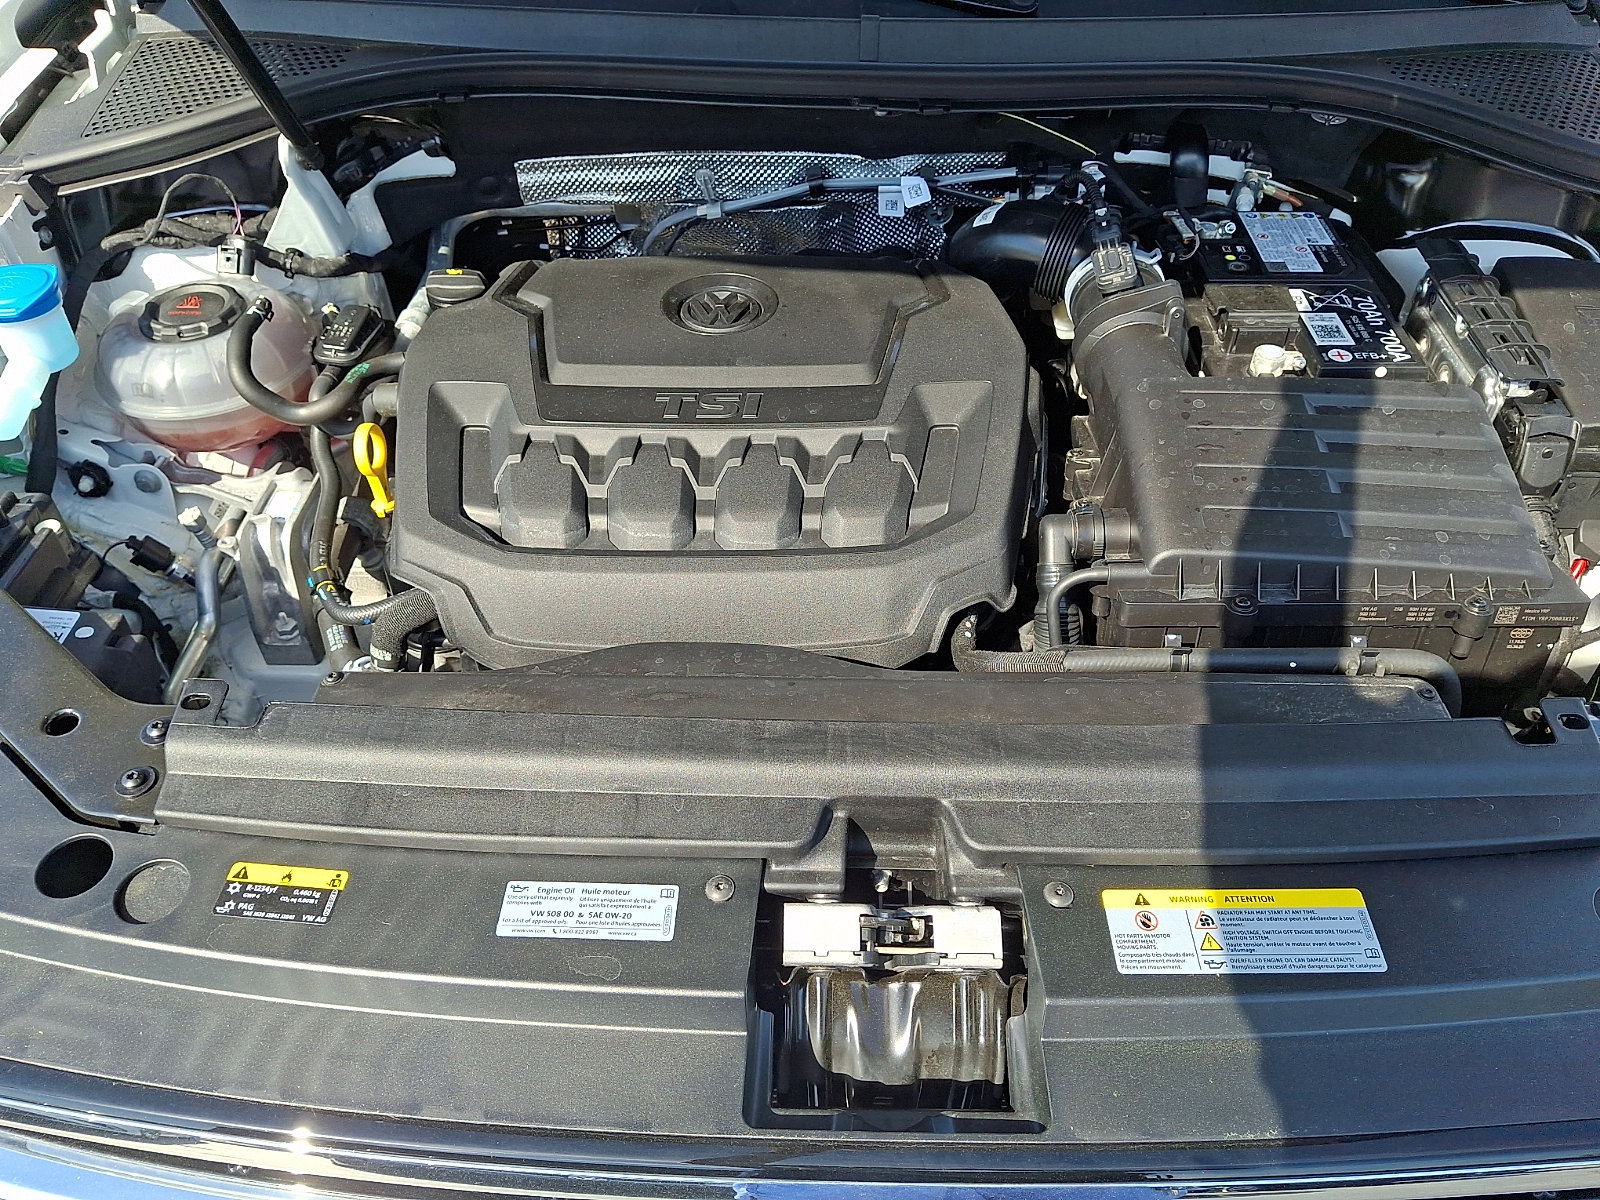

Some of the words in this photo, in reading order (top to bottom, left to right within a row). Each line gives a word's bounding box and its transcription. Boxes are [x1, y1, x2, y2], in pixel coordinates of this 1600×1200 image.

[1353, 296, 1386, 326] 70Ah
[1374, 329, 1412, 363] 700A
[1354, 352, 1388, 360] EFB+
[654, 392, 764, 419] TSI
[246, 884, 279, 895] R-1234yf
[537, 886, 562, 895] Engine
[1224, 895, 1275, 903] ATTENTION
[237, 902, 255, 911] PAG
[588, 911, 603, 919] SAE
